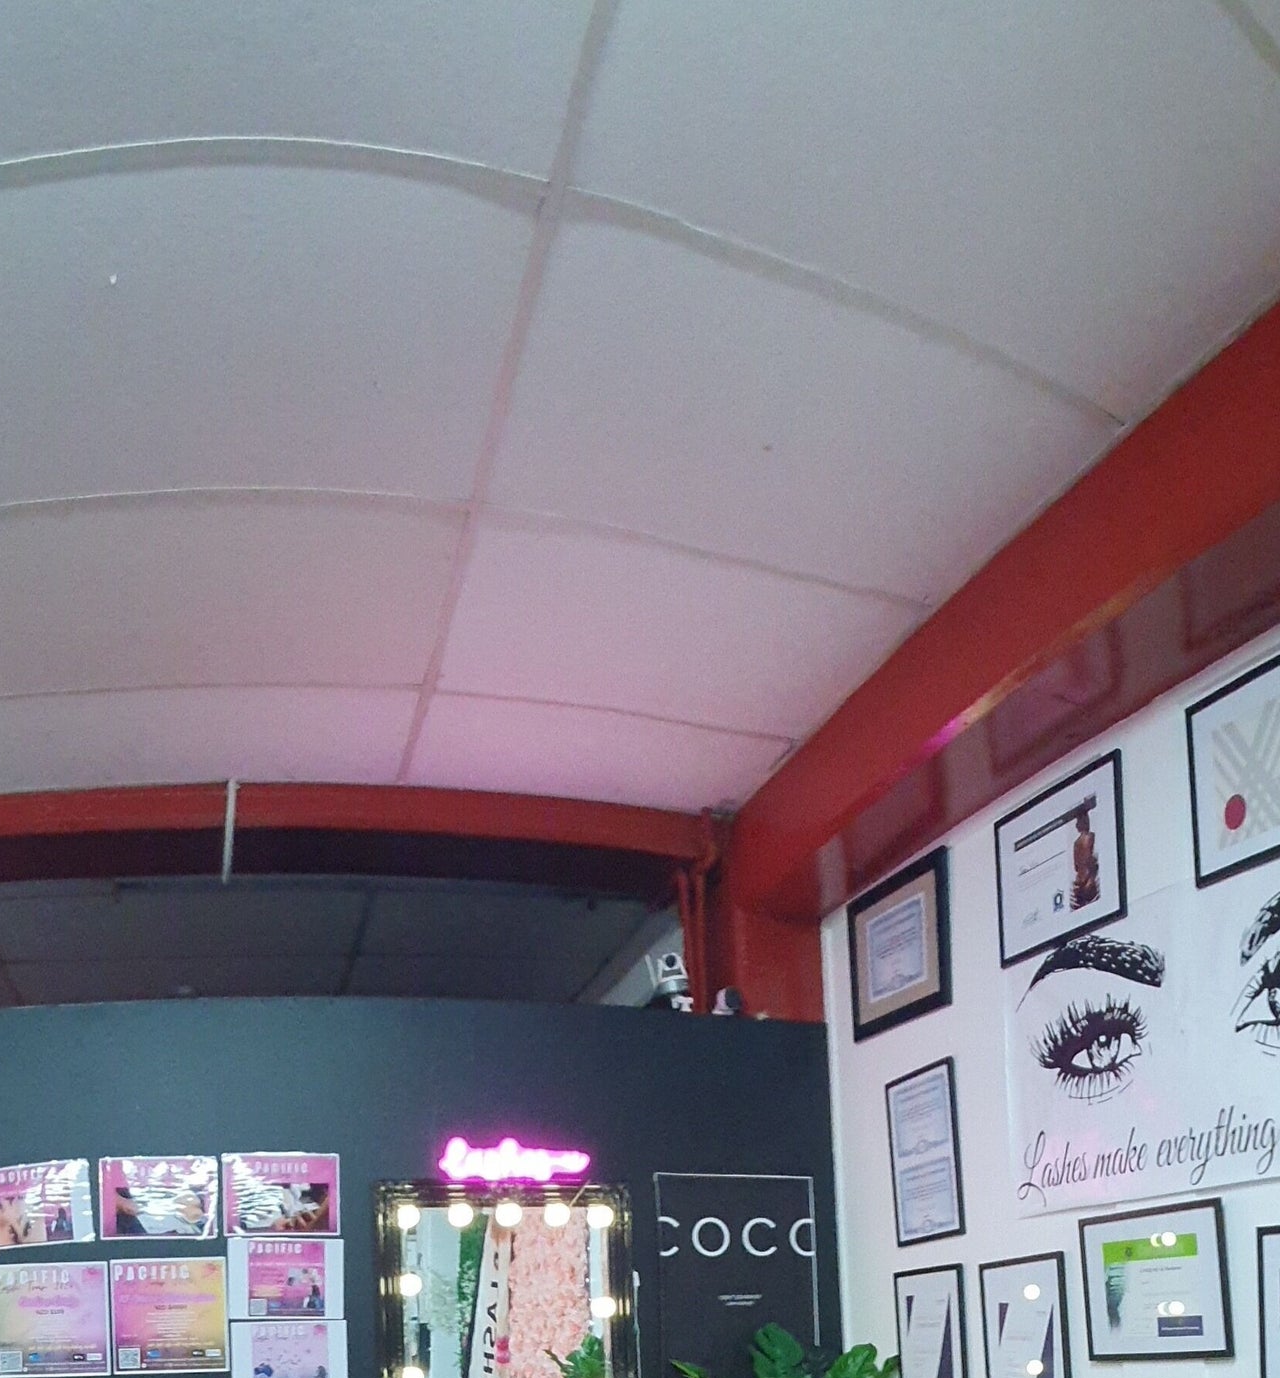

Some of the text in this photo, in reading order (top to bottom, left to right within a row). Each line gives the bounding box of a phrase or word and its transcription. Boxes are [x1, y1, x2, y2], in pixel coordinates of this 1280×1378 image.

[1017, 1129, 1088, 1208] Lashes
[1093, 1127, 1149, 1180] make
[1156, 1105, 1279, 1186] everything
[113, 1264, 190, 1282] PACIFIC
